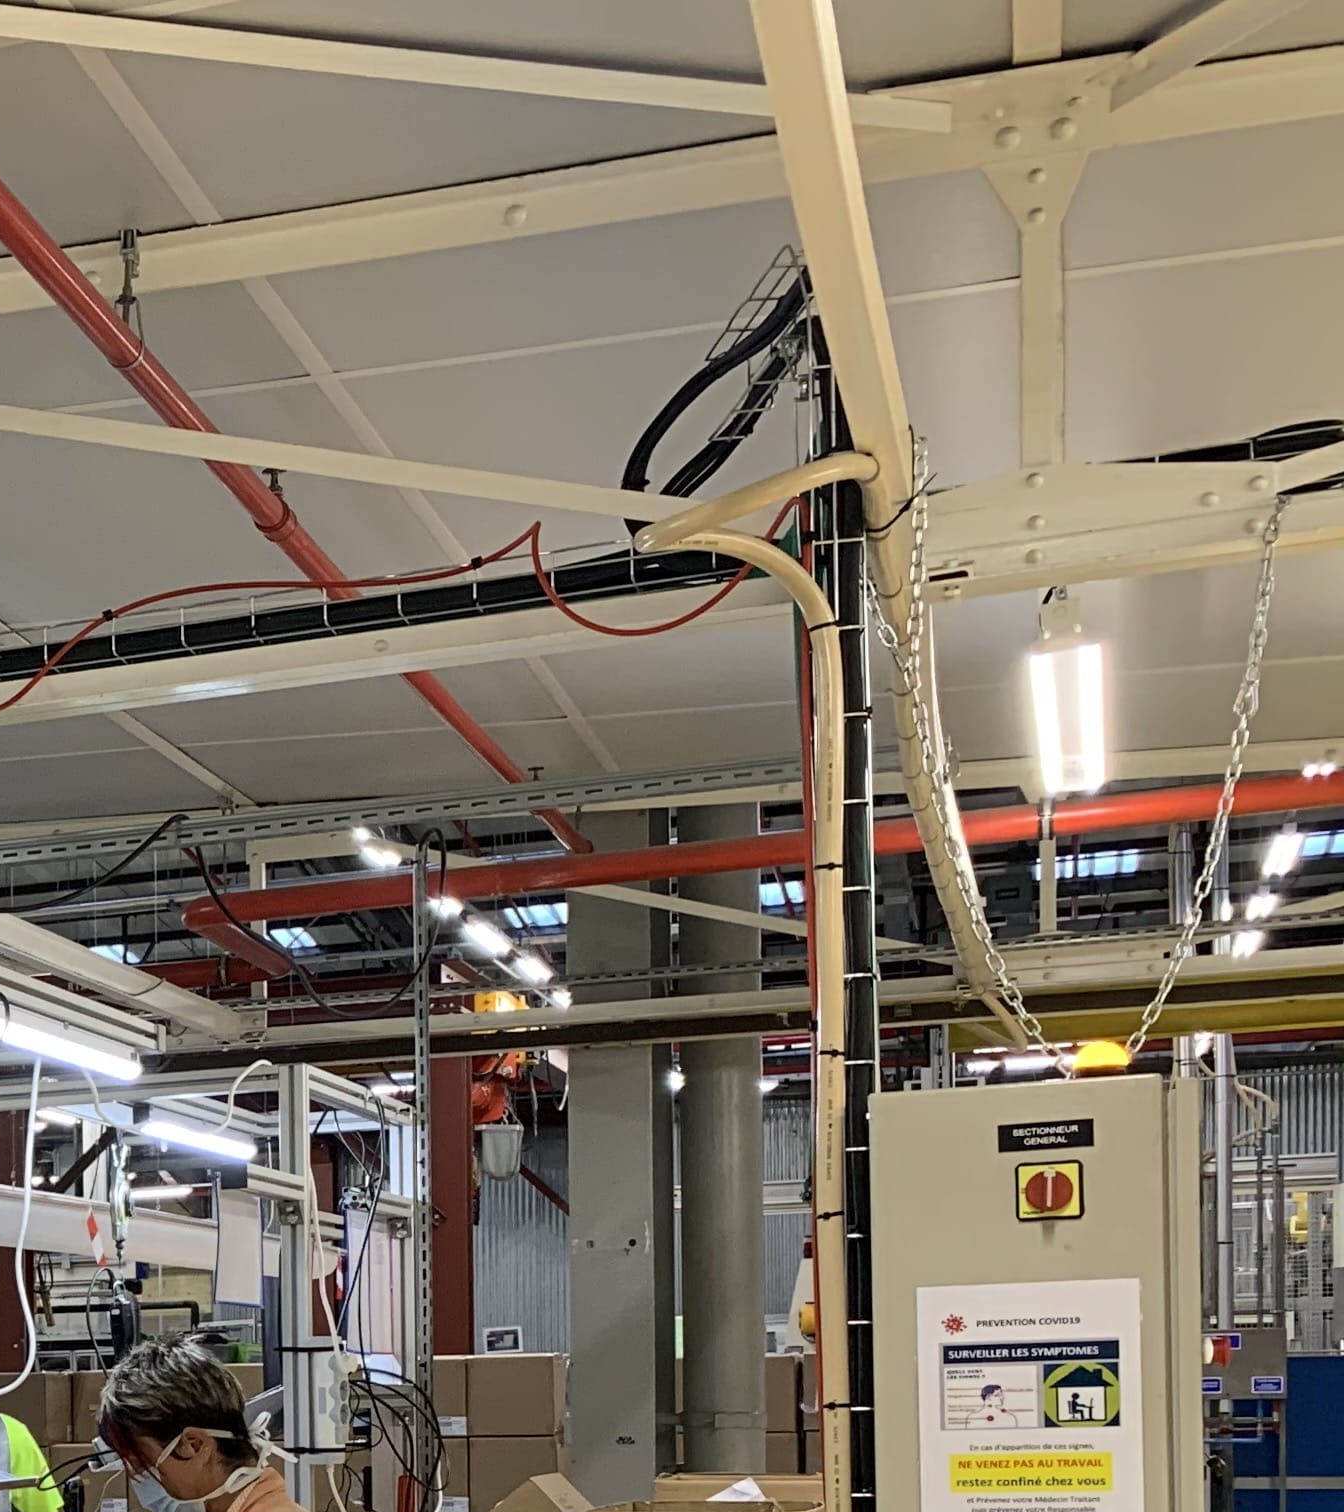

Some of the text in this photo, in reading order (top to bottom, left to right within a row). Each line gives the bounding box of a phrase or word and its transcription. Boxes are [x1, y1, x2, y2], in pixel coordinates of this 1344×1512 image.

[1013, 1125, 1079, 1136] SECTIONNEUR
[1023, 1136, 1068, 1145] GENERAL
[976, 1317, 1081, 1328] PREVENTION COVID19
[948, 1345, 1099, 1359] SURVEILLER LES SYMPTOMES
[958, 1458, 1104, 1469] NE VENEZ PAS AU TRAVAIL
[956, 1476, 1106, 1487] restez confiné chez vous
[1034, 1495, 1068, 1503] Médecin
[1070, 1495, 1100, 1503] Traitant
